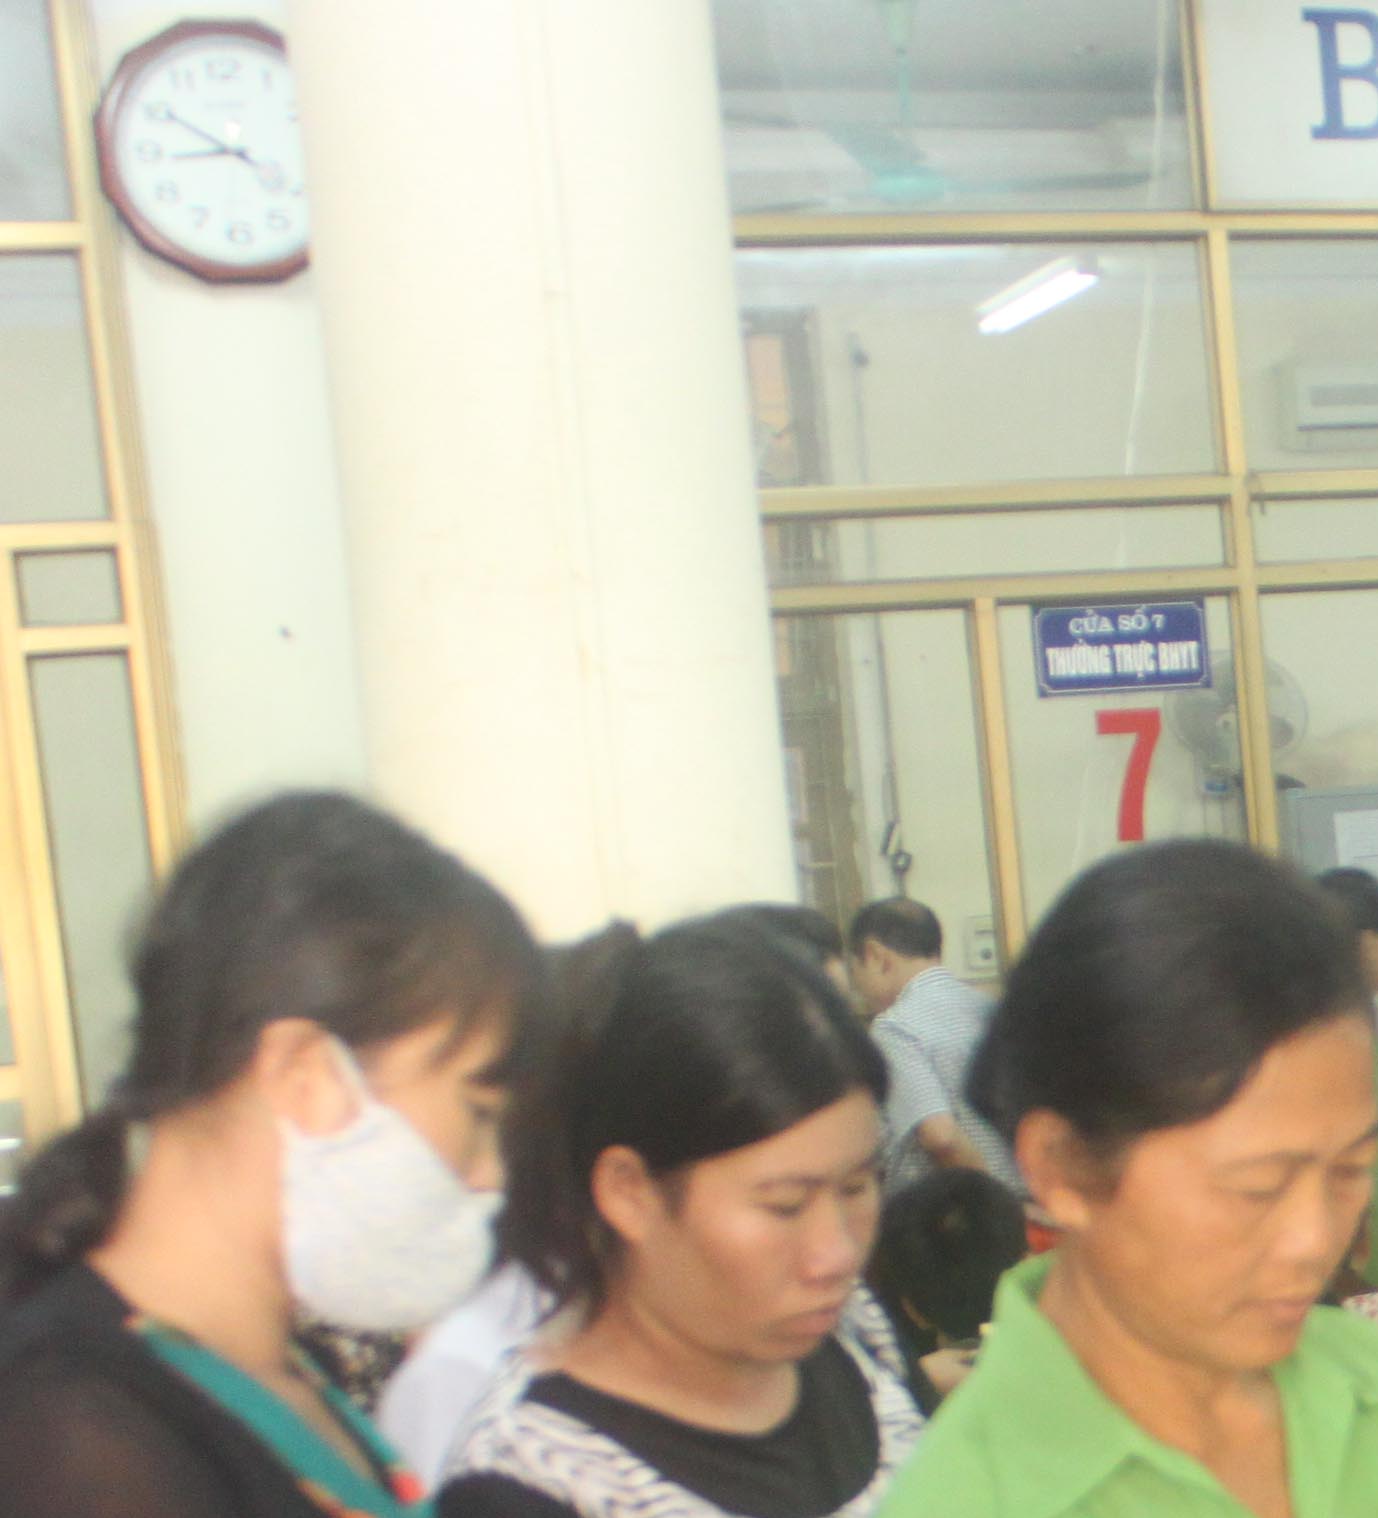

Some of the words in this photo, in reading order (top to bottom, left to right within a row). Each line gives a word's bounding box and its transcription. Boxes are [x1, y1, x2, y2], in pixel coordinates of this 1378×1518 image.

[169, 68, 197, 93] 11
[204, 57, 242, 82] 12
[262, 66, 275, 93] 1
[136, 138, 164, 163] 9
[154, 180, 180, 203] 8
[188, 204, 210, 228] 7
[265, 208, 291, 232] 5
[225, 221, 252, 245] 6
[1067, 608, 1115, 635] CỬA
[1117, 604, 1150, 631] SỐ
[1151, 614, 1166, 631] 7
[1096, 708, 1162, 842] 7
